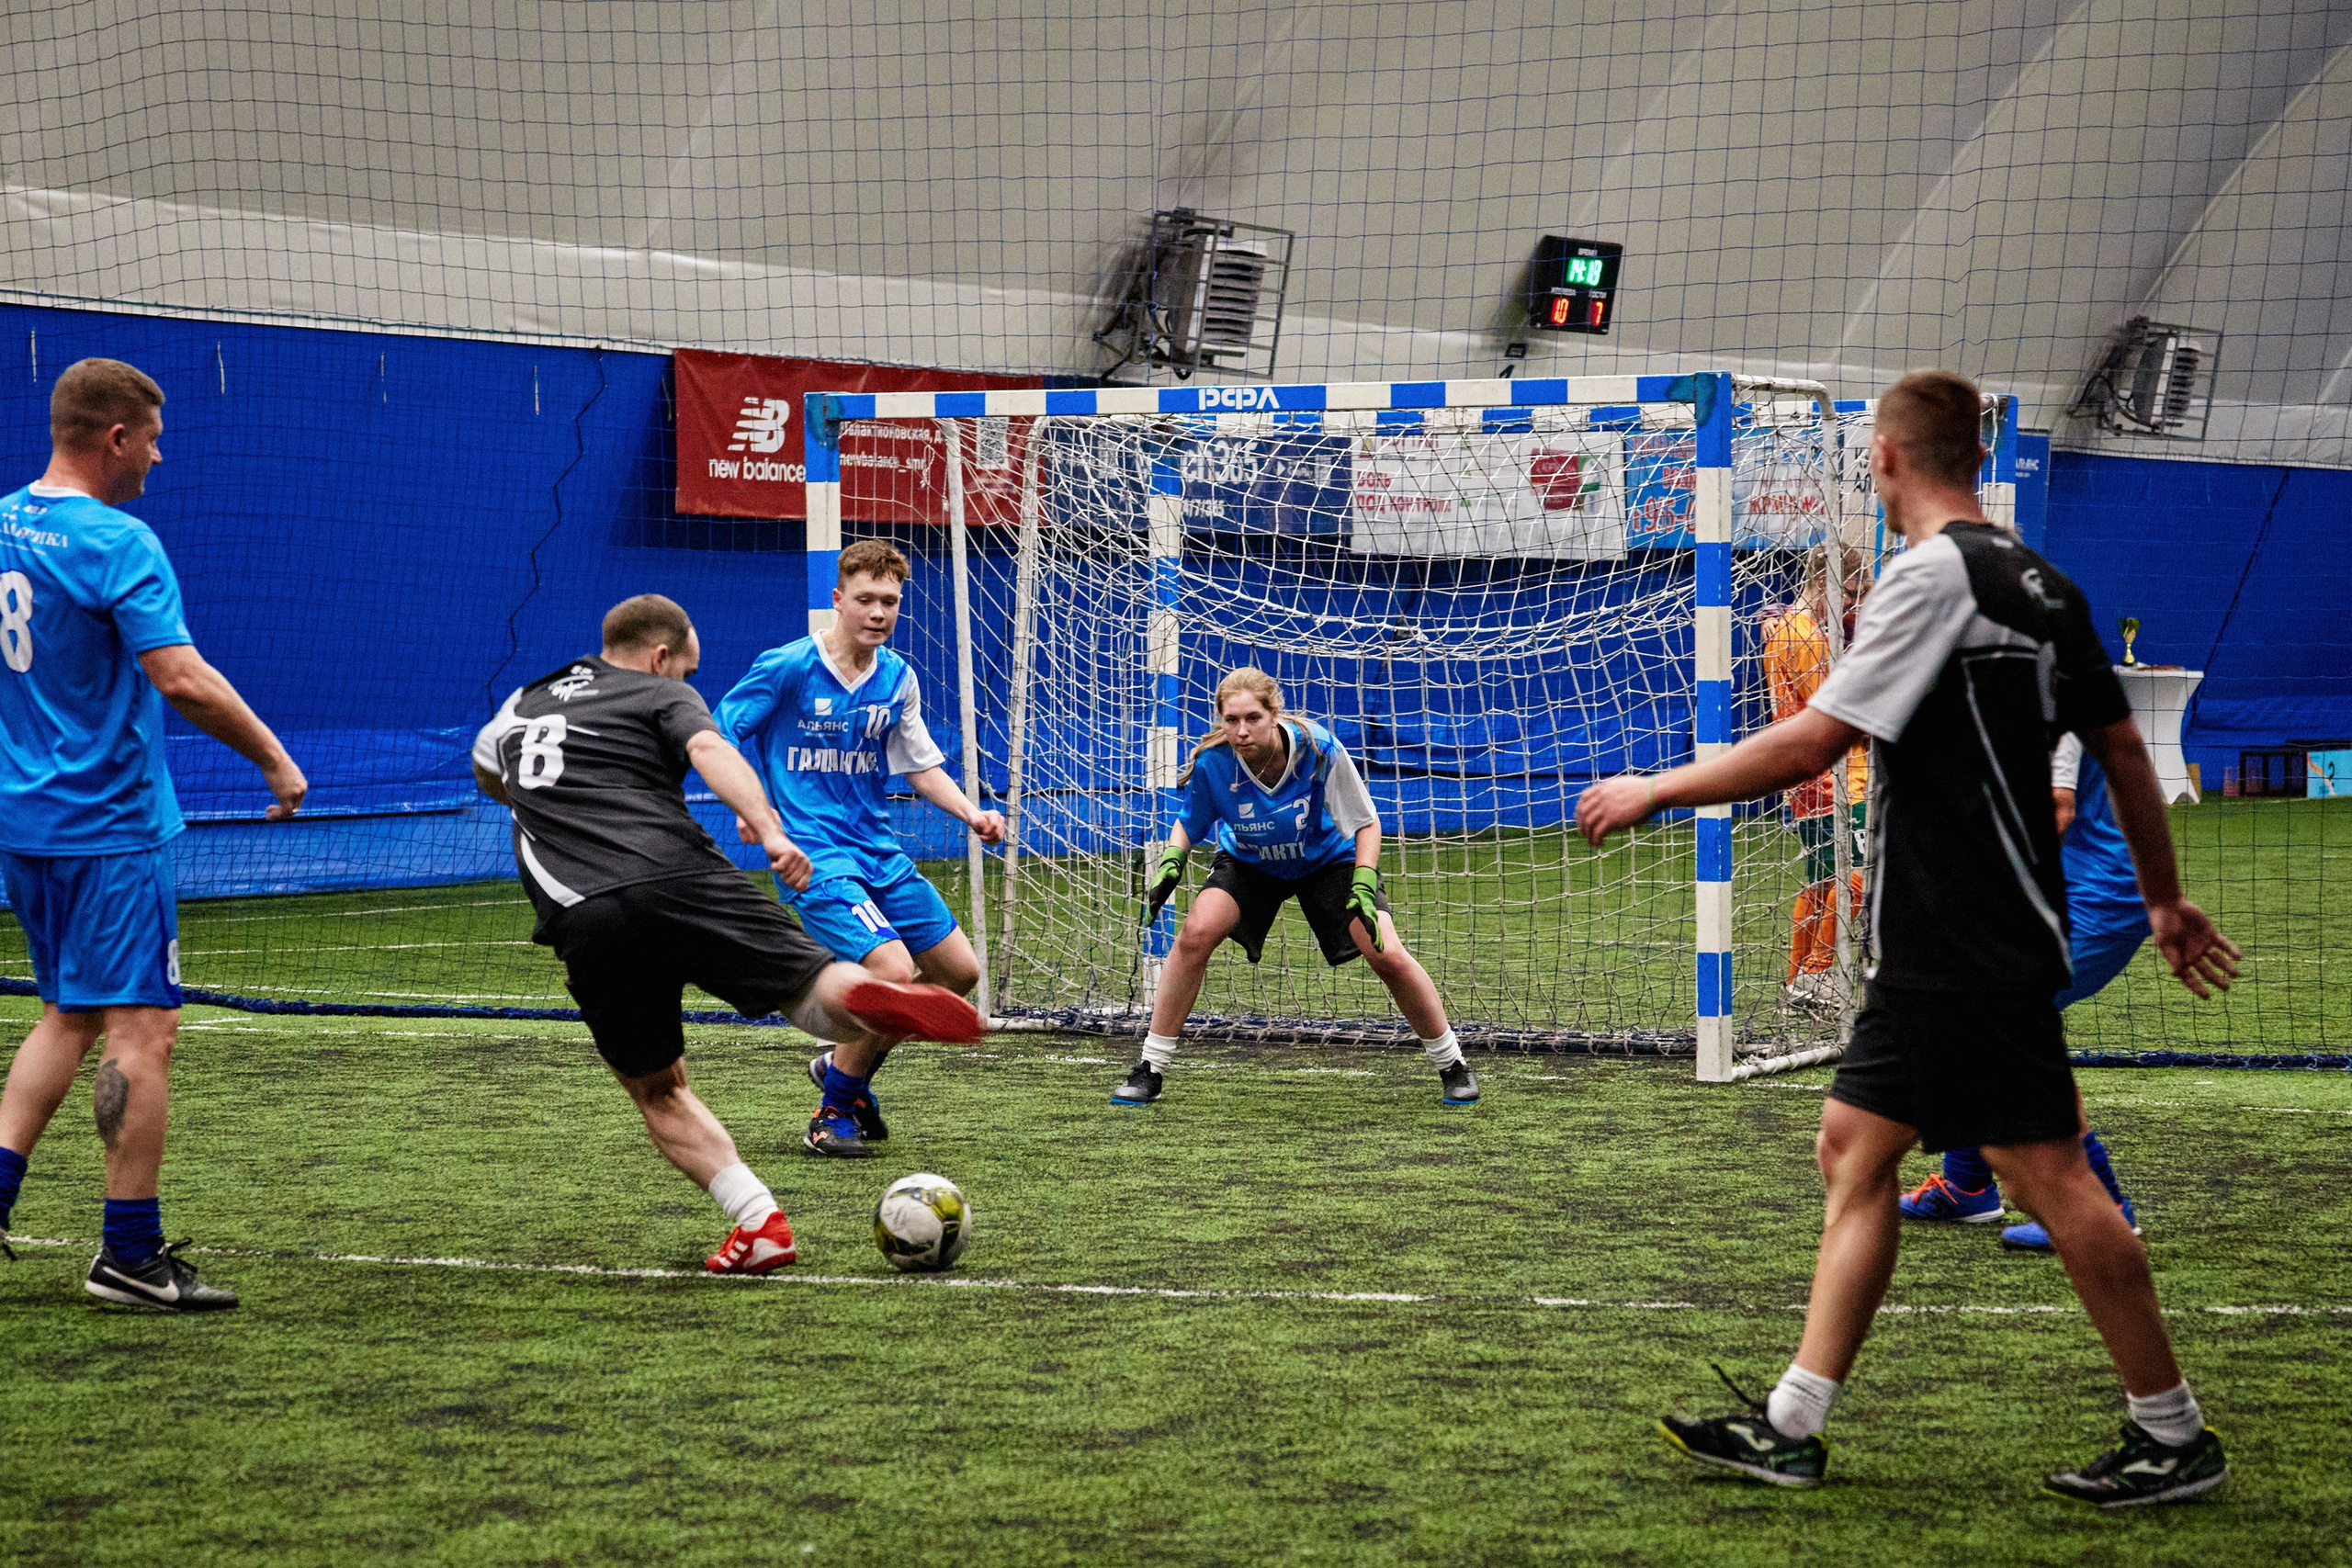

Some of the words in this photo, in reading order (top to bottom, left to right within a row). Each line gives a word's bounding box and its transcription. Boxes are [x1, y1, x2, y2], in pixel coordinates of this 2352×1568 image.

[1553, 298, 1570, 324] 10
[708, 458, 741, 479] new
[743, 456, 807, 483] balance
[1357, 470, 1392, 489] БОЛЬ
[0, 570, 33, 673] 8
[797, 718, 849, 733] АЛЬЯНС
[865, 704, 891, 740] 10
[518, 714, 567, 791] 8
[1292, 797, 1310, 831] 2
[851, 898, 890, 934] 10
[166, 938, 181, 987] 8
